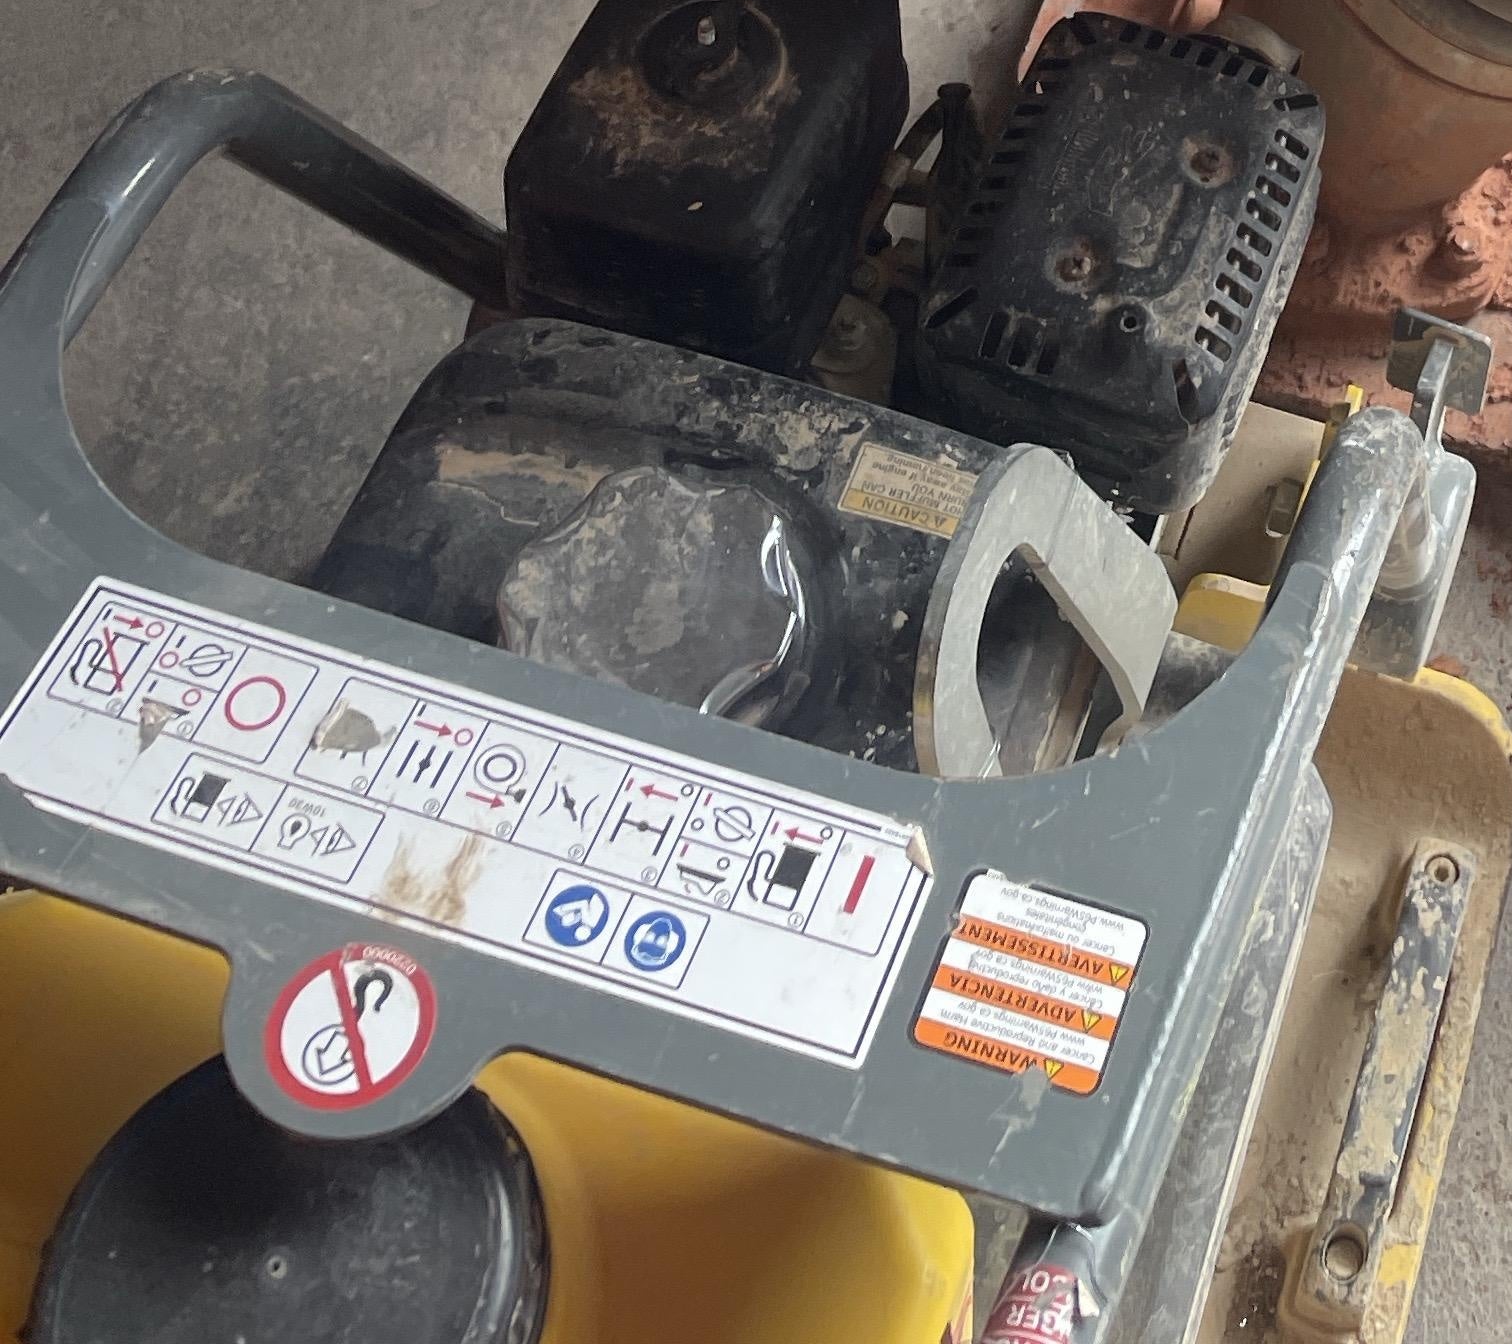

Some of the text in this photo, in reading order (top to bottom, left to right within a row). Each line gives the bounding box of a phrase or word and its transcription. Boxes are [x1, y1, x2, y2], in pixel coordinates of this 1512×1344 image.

[871, 460, 908, 477] engine
[861, 479, 886, 495] CAN
[888, 487, 941, 510] MUFFLER
[910, 483, 935, 497] YOU
[861, 495, 930, 525] CAUTION
[959, 918, 1104, 979] AVERTISSEMENT
[946, 970, 1077, 1026] ADVERTENCIA
[939, 1008, 1096, 1066] Cancer and Reproductive Harm
[942, 1028, 1039, 1074] WARNING
